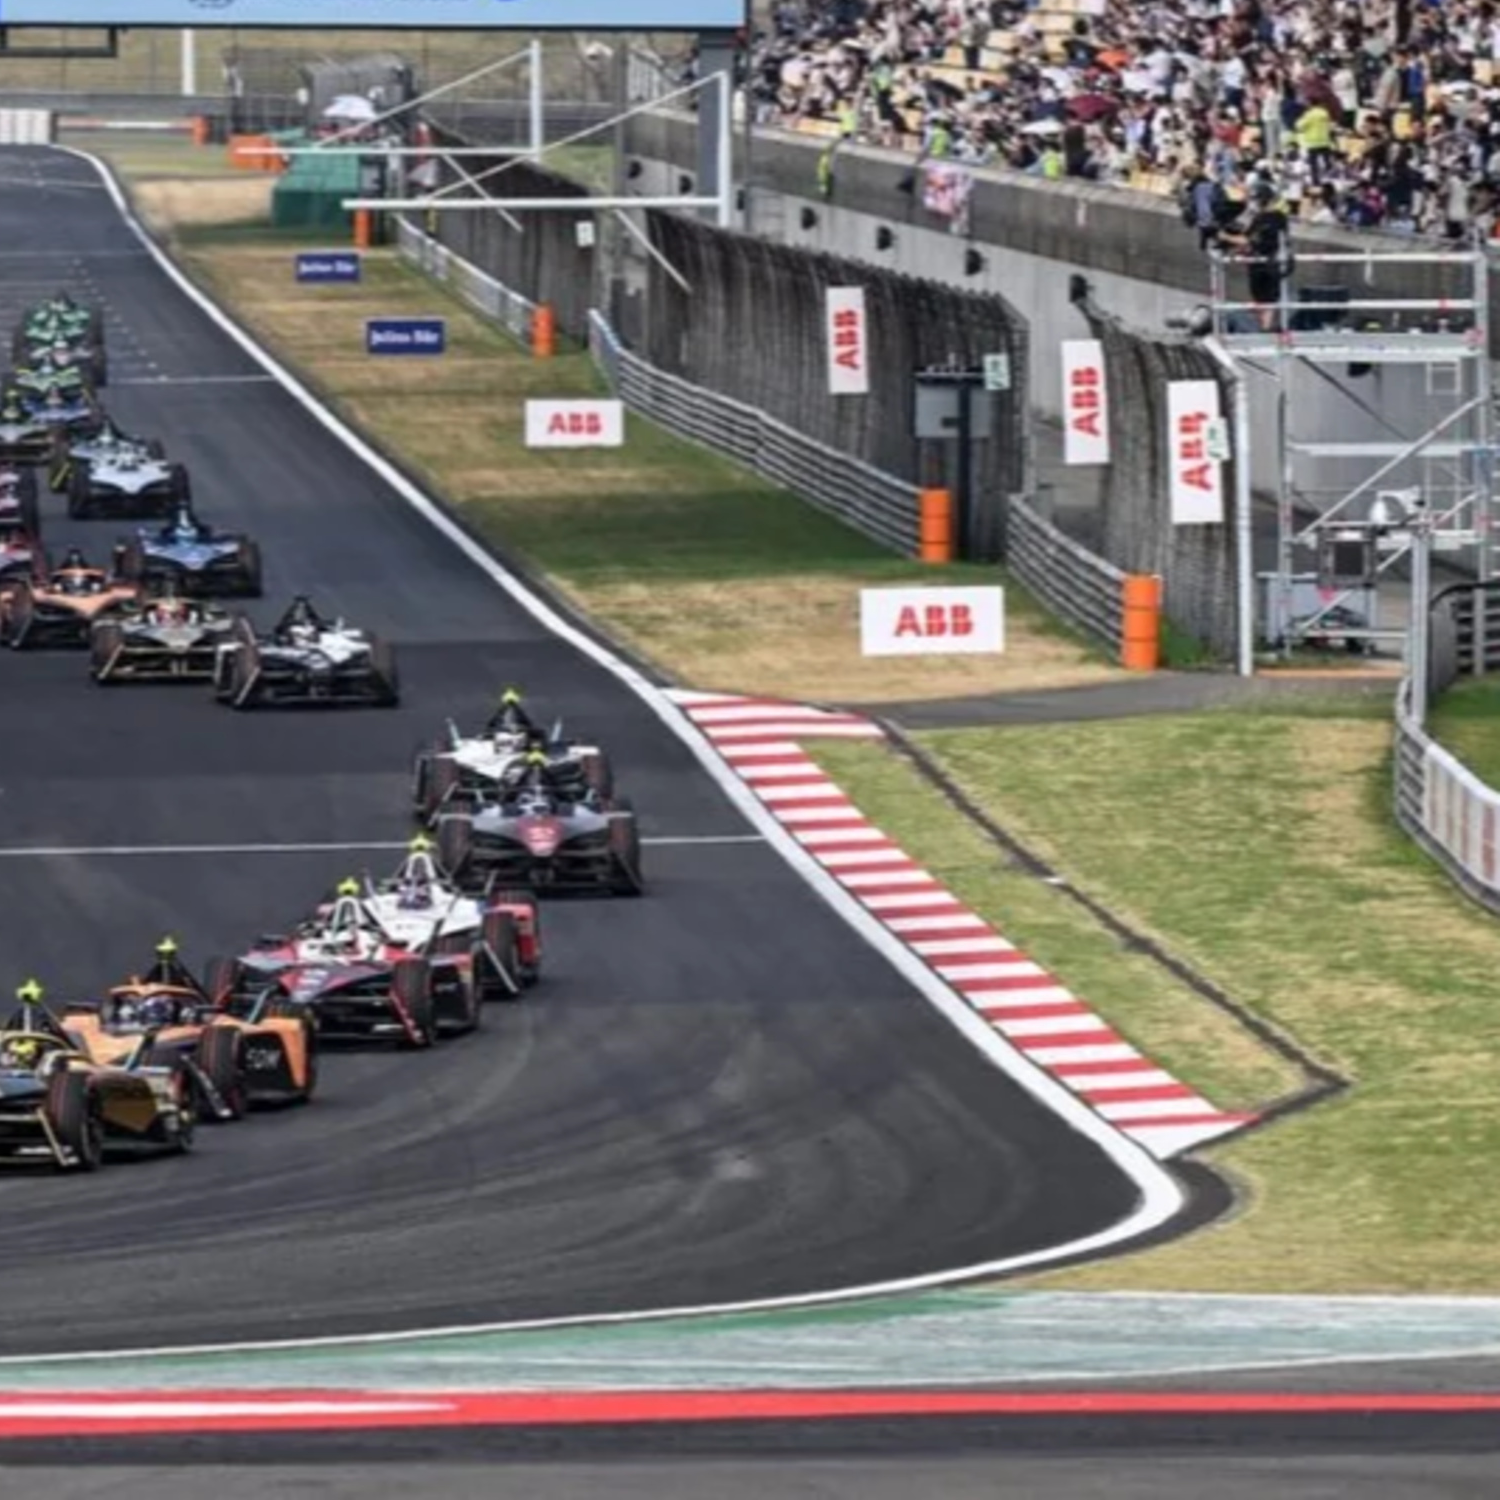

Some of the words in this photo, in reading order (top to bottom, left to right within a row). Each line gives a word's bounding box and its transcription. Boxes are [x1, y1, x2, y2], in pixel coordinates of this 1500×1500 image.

[833, 308, 860, 371] ABB
[548, 411, 603, 436] ABB
[1071, 365, 1100, 438] ABB
[893, 604, 975, 638] ABB
